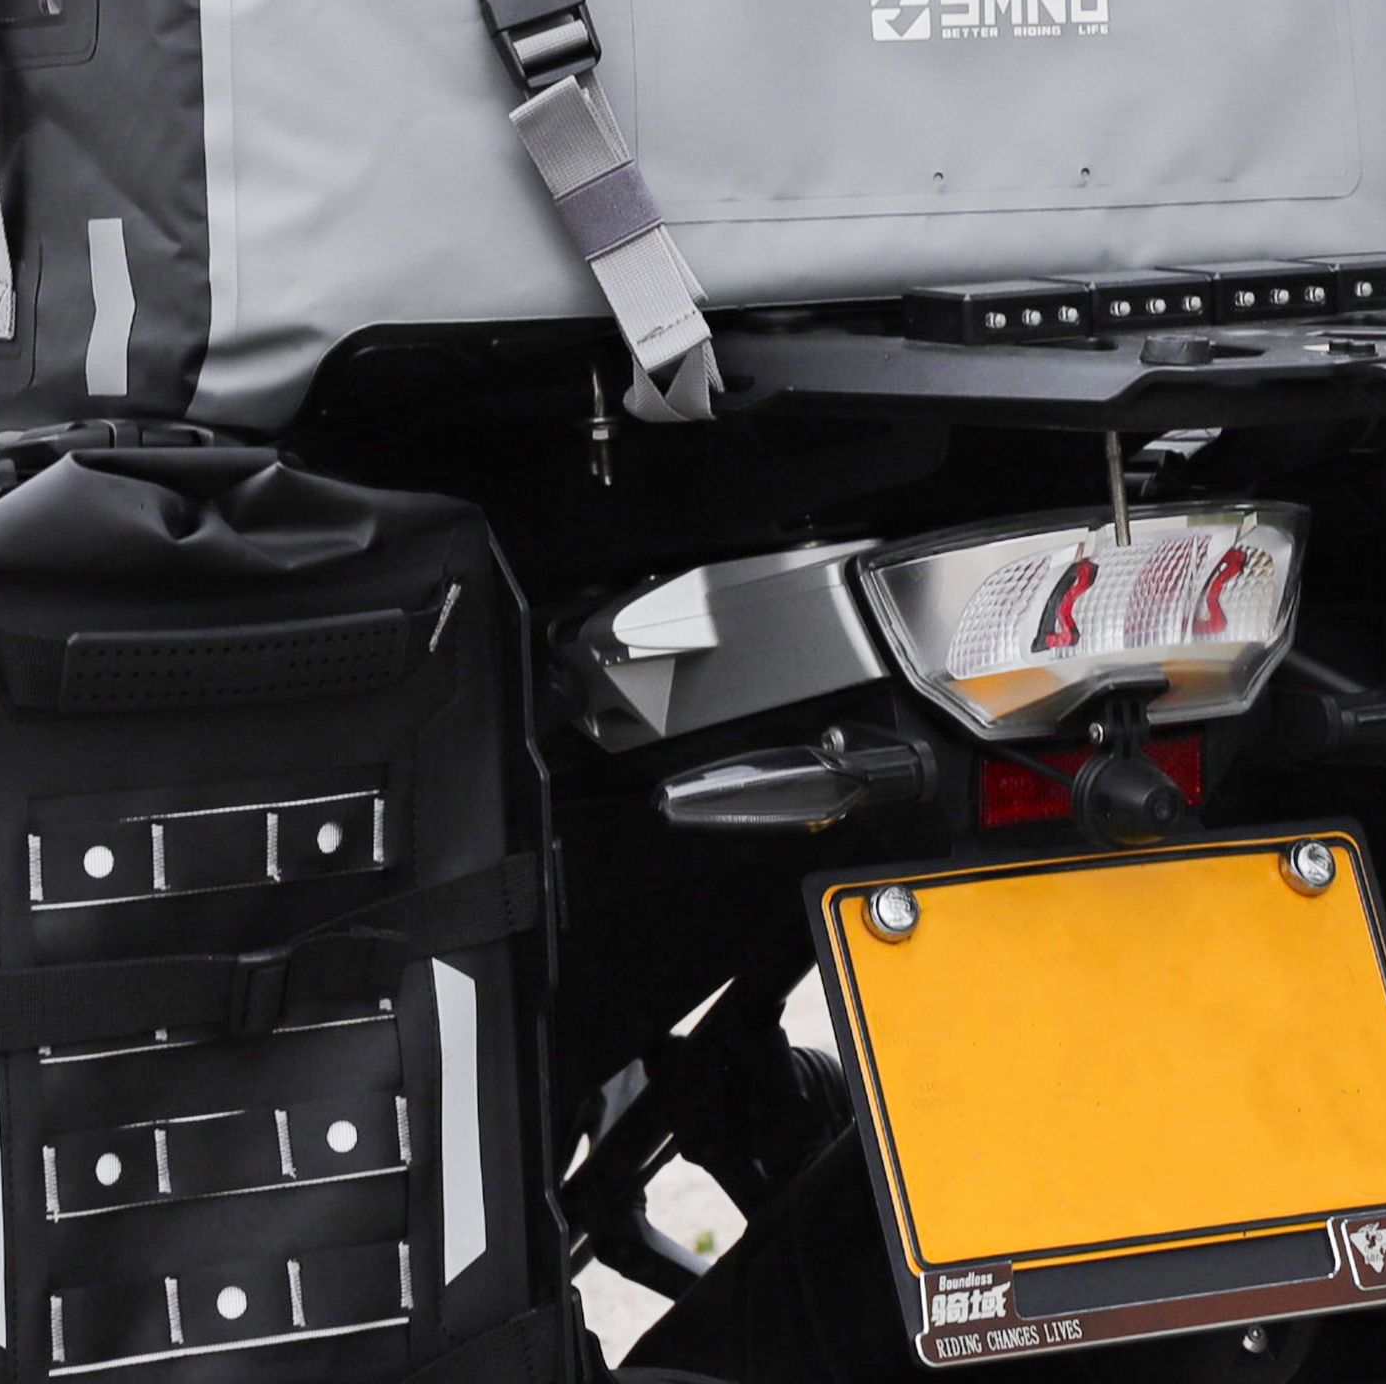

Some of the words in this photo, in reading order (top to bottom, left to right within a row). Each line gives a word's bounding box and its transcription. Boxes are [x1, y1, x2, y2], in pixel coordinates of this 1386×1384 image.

[941, 26, 999, 39] BETTER
[1013, 25, 1062, 37] RIDING
[1078, 24, 1109, 35] LIFE
[935, 1333, 983, 1359] RIDING
[986, 1325, 1040, 1352] CHANGES
[1043, 1320, 1083, 1343] LIVES
